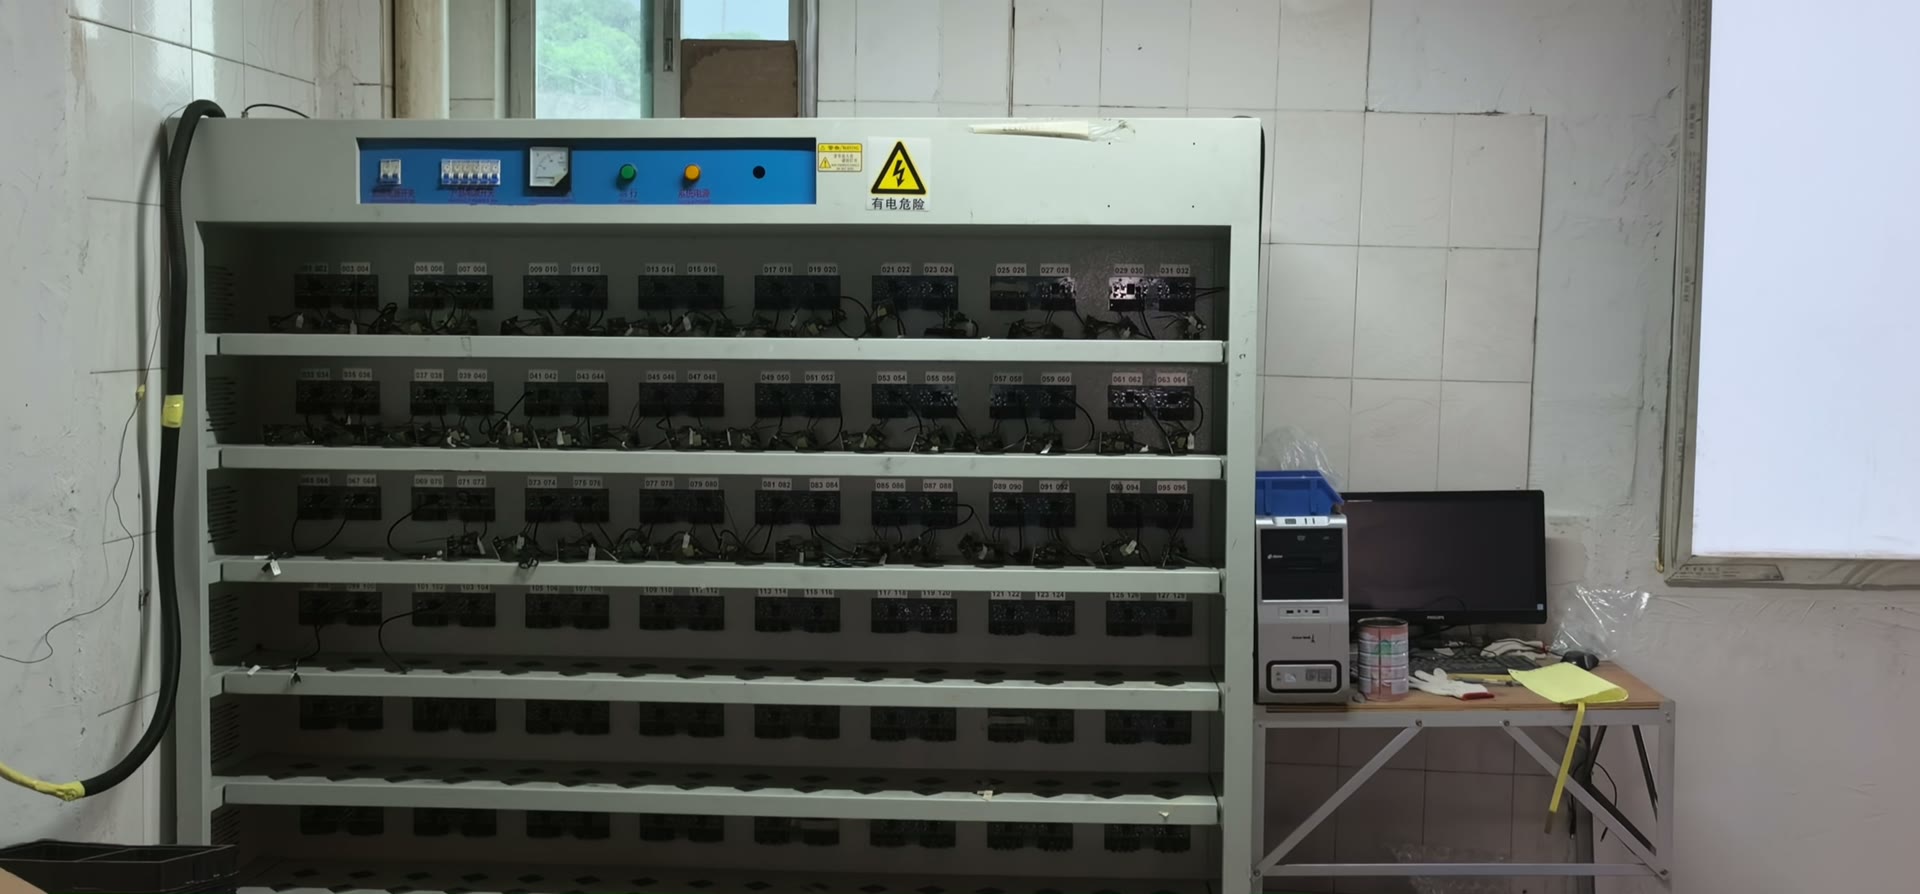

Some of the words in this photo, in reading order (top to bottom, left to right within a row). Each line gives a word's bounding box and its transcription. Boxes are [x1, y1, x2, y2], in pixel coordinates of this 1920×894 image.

[871, 197, 925, 210] 有电危险
[342, 265, 356, 273] 003
[357, 265, 369, 273] 004
[416, 265, 428, 273] 005
[430, 265, 443, 273] 006
[458, 265, 472, 273] 007
[473, 265, 486, 273] 008
[344, 371, 357, 379] 035
[358, 371, 370, 379] 036
[416, 371, 429, 379] 037
[430, 371, 442, 379] 038
[459, 371, 472, 379] 039
[473, 371, 486, 379] 040
[348, 477, 361, 485] 067
[362, 477, 375, 485] 068
[416, 477, 428, 485] 069
[430, 477, 442, 485] 070
[458, 477, 471, 485] 071
[473, 477, 485, 485] 072
[763, 480, 777, 488] 081
[778, 480, 790, 488] 082
[810, 480, 824, 488] 083
[826, 480, 838, 488] 084
[876, 480, 890, 488] 085
[892, 480, 904, 488] 086
[924, 480, 938, 488] 087
[939, 480, 952, 488] 088
[994, 482, 1007, 490] 089
[1009, 482, 1022, 490] 090
[1040, 482, 1054, 490] 091
[1125, 482, 1138, 490] 094
[1158, 482, 1172, 491] 095
[1173, 482, 1186, 491] 096
